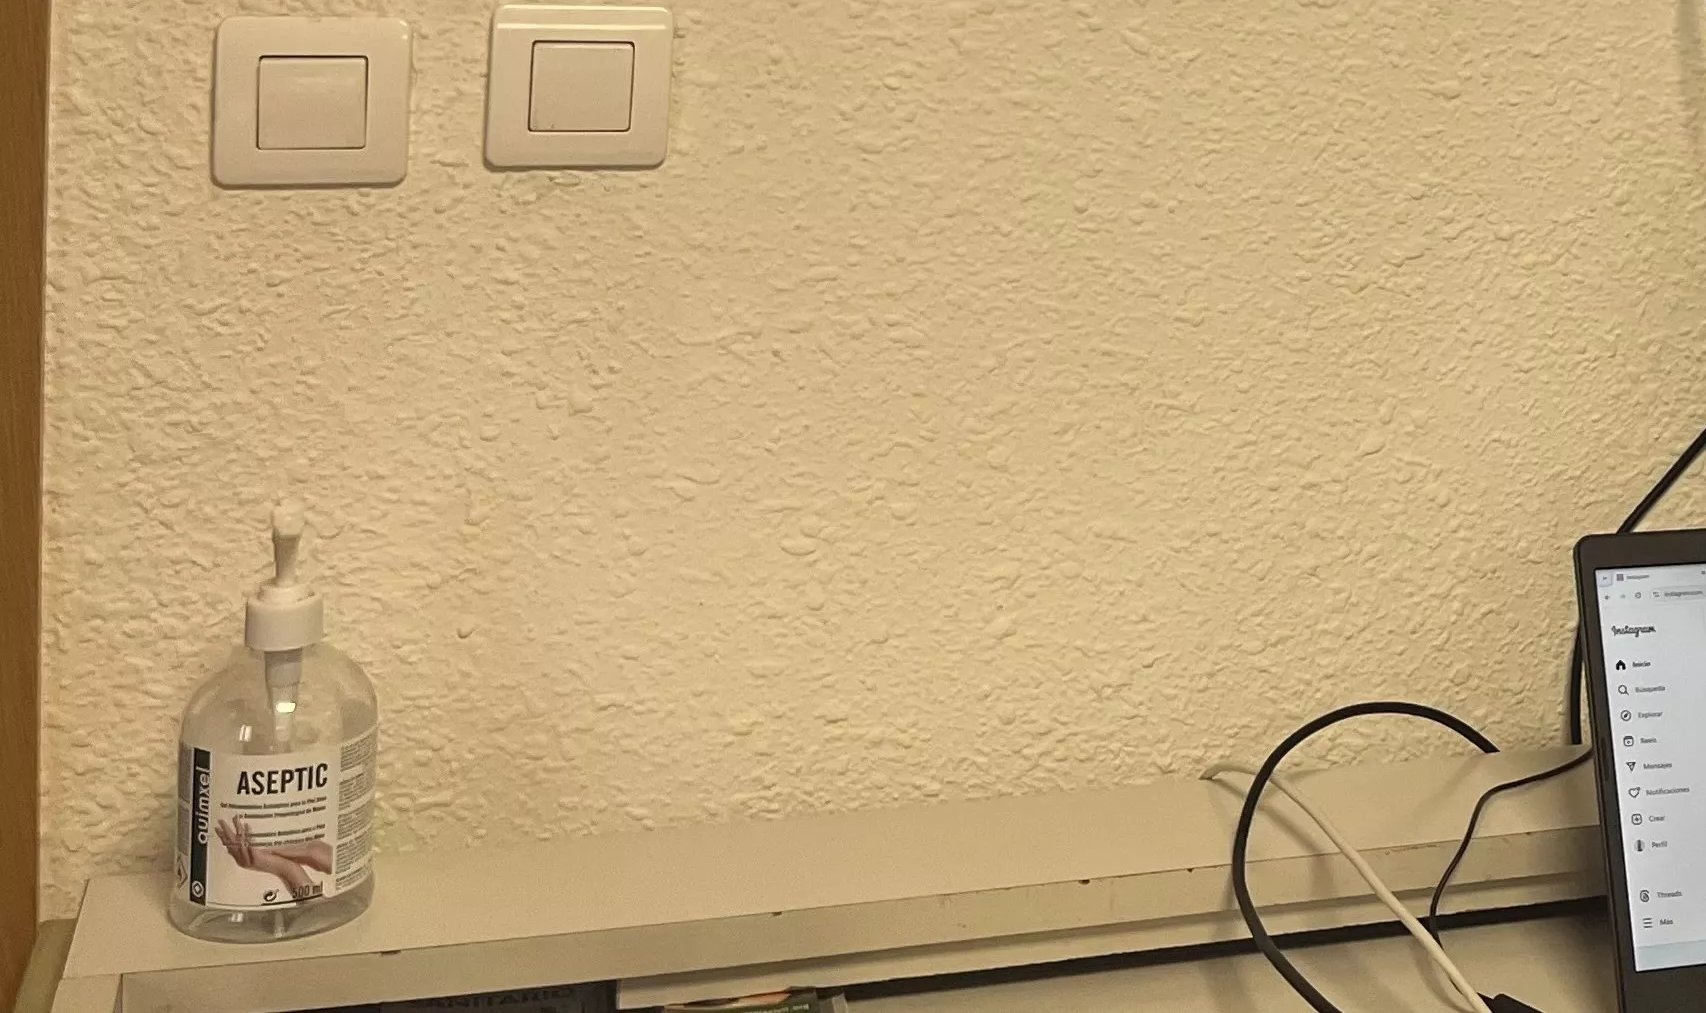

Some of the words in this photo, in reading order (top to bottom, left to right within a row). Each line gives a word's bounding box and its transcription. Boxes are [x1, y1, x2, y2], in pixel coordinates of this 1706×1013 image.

[1610, 625, 1656, 639] Instagram
[236, 762, 329, 796] ASEPTIC
[291, 885, 310, 899] 500
